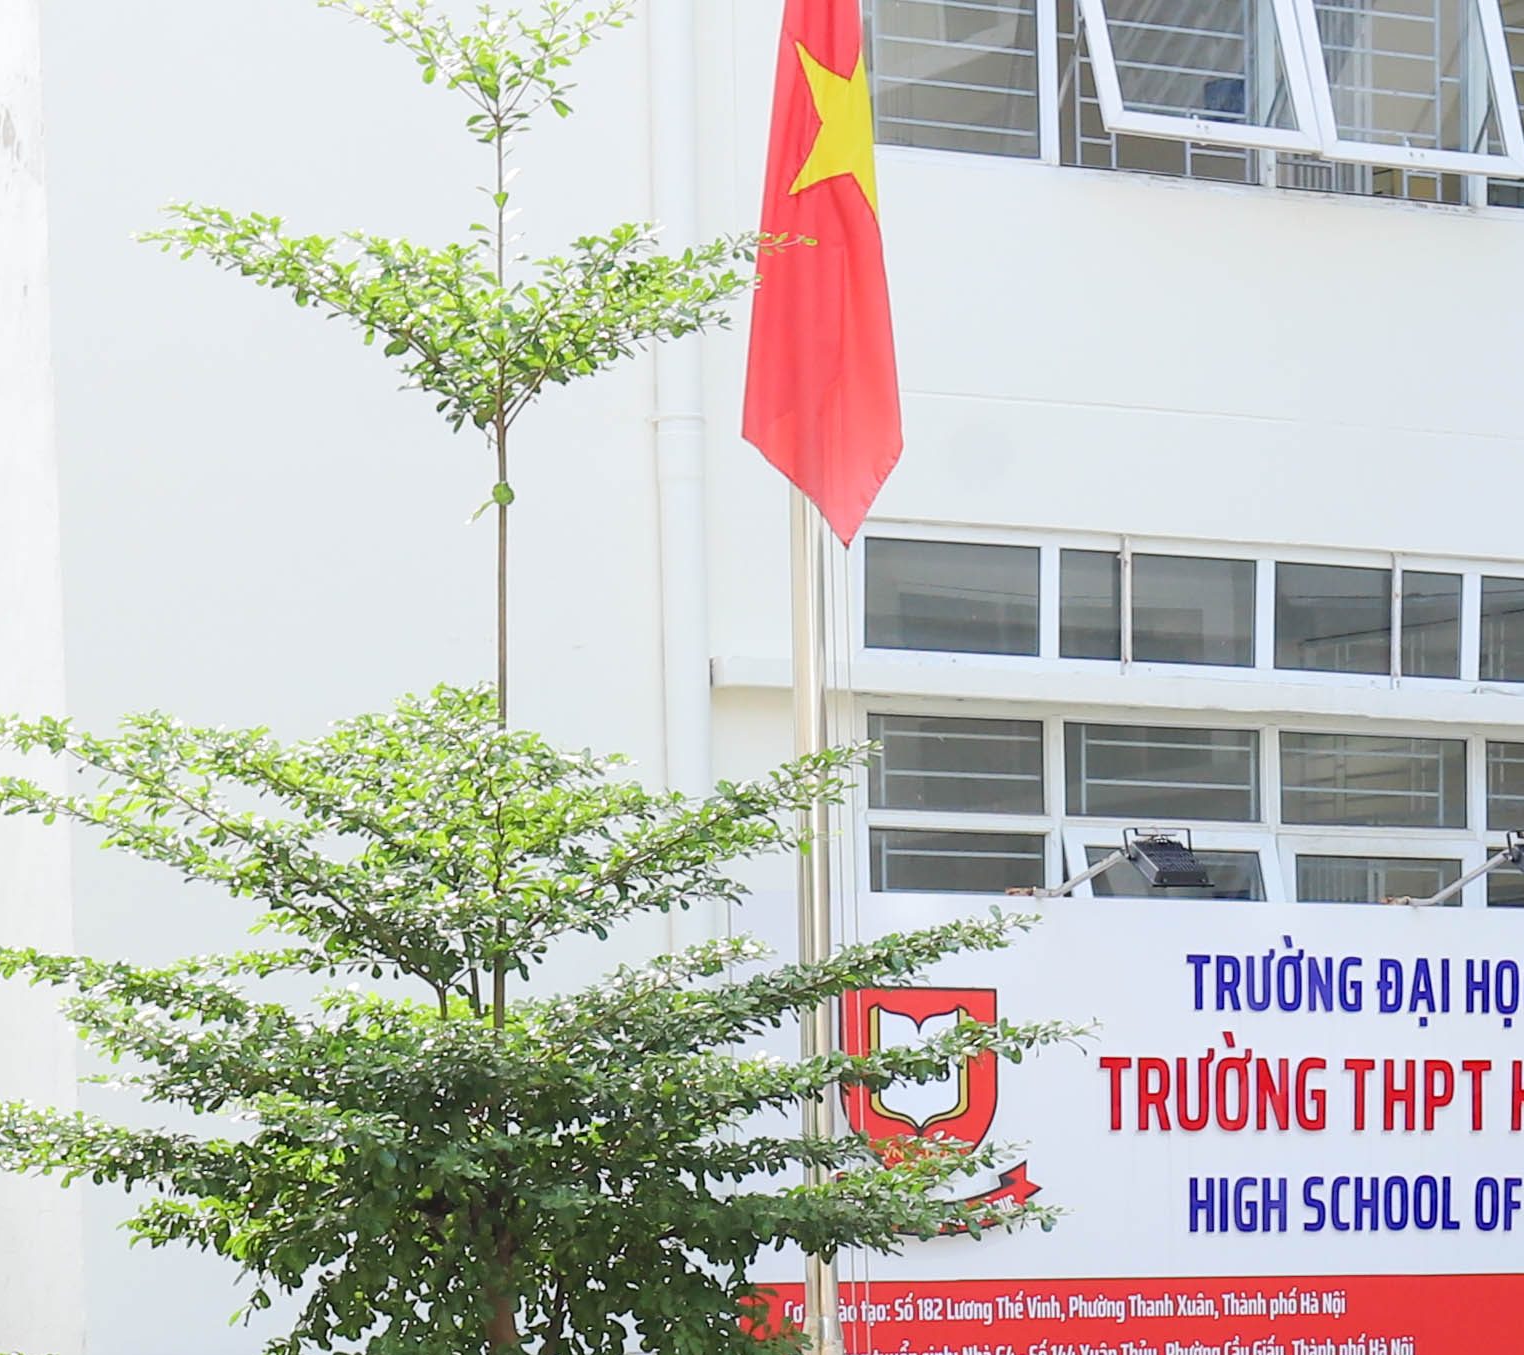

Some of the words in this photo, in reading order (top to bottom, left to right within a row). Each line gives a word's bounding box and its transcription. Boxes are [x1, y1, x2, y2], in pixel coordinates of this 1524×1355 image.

[1186, 935, 1363, 1013] TRƯỜNG
[1377, 958, 1450, 1027] ĐẠI
[1099, 1031, 1327, 1132] TRƯỜNG
[1344, 1058, 1492, 1132] THPT
[1188, 1176, 1288, 1233] HIGH
[1303, 1175, 1461, 1232] SCHOOL
[1475, 1176, 1523, 1232] OF
[894, 1293, 914, 1322] Số
[917, 1298, 943, 1321] 182
[947, 1296, 993, 1325] Lương
[996, 1290, 1024, 1320] Thế
[1026, 1295, 1065, 1322] Vinh,
[1067, 1293, 1125, 1323] Phường
[1128, 1294, 1174, 1318] Thanh
[1177, 1291, 1219, 1320] Xuân,
[1221, 1290, 1267, 1317] Thành
[1270, 1287, 1297, 1320] phố
[1301, 1291, 1319, 1315] Hà
[1322, 1290, 1346, 1319] Nội
